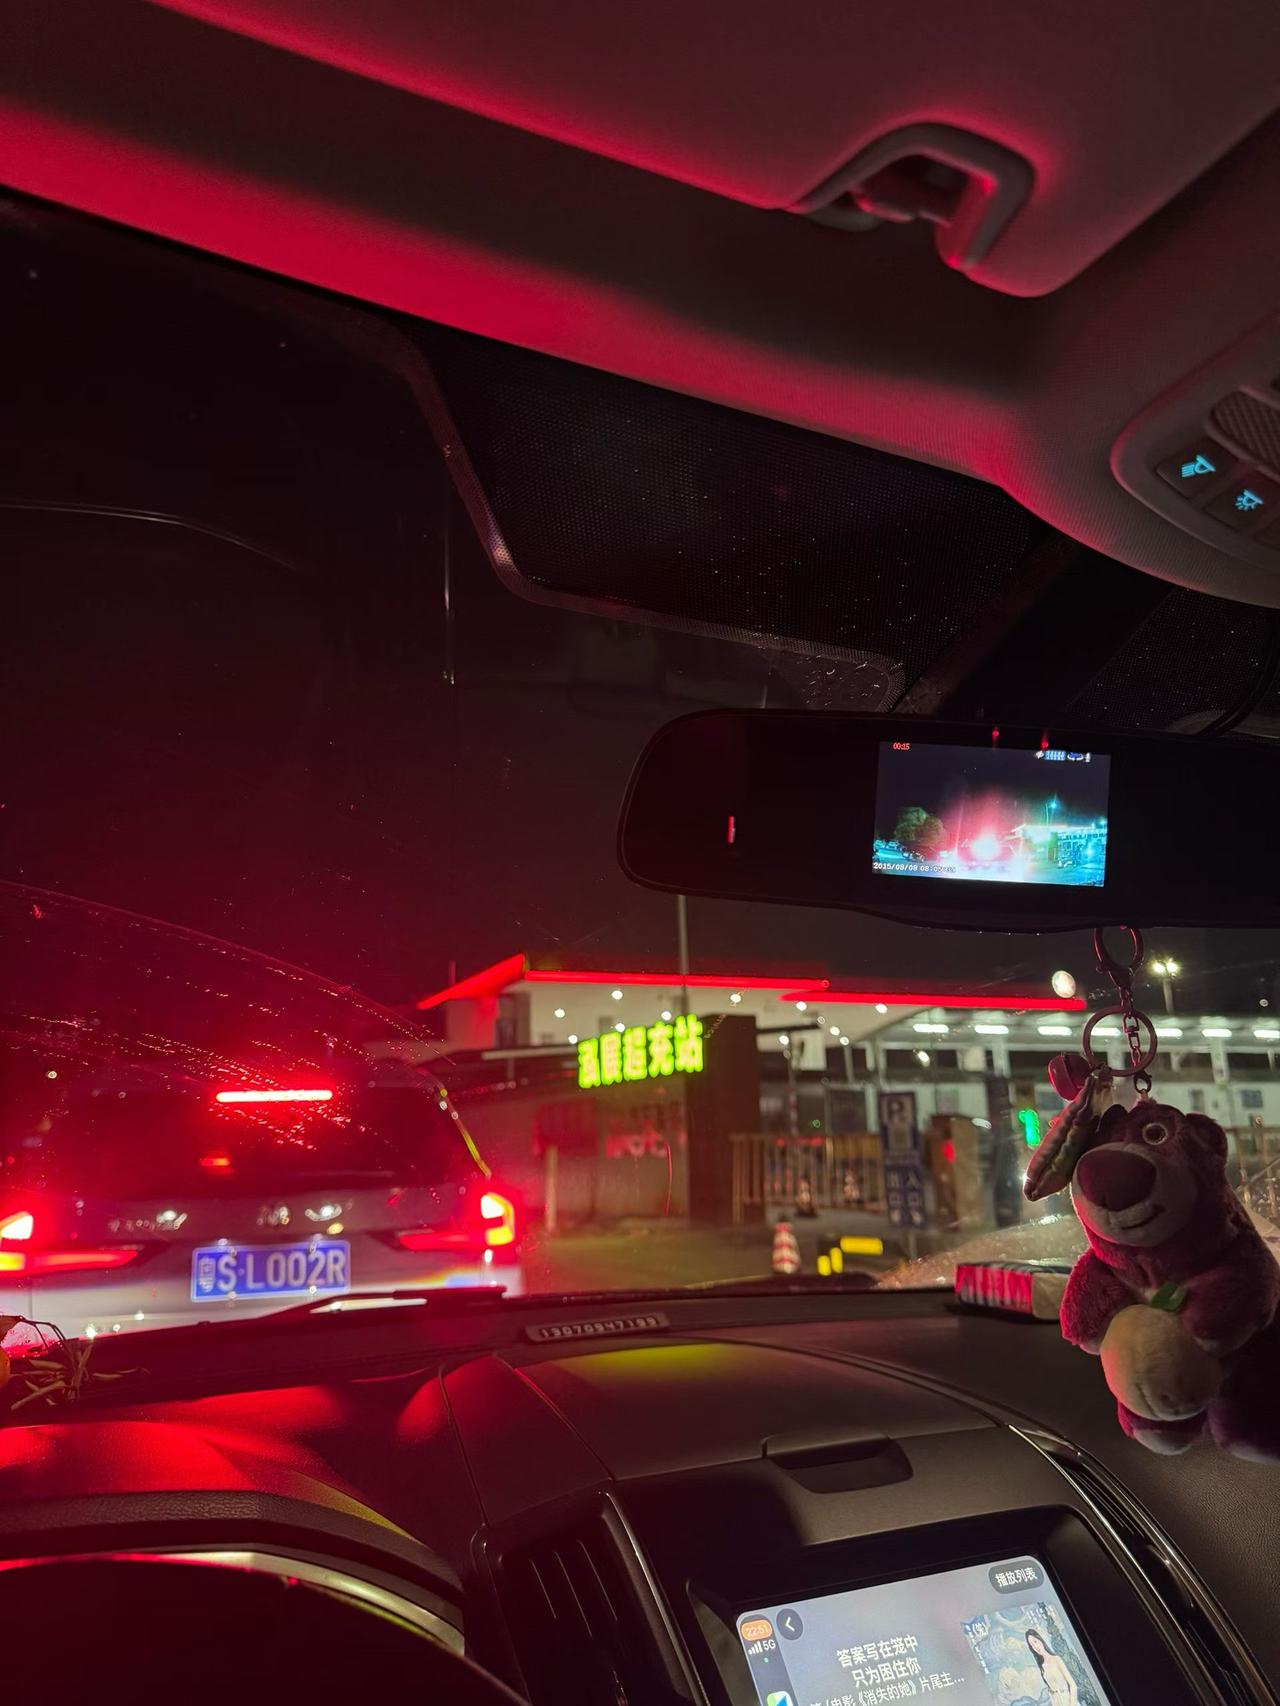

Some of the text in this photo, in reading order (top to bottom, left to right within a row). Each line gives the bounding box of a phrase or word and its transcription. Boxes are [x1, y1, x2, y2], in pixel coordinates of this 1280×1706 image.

[995, 1567, 1038, 1588] 播放列表
[763, 1639, 776, 1651] 5G
[837, 1634, 919, 1668] 答案写在笼中
[852, 1657, 922, 1687] 只为困住你
